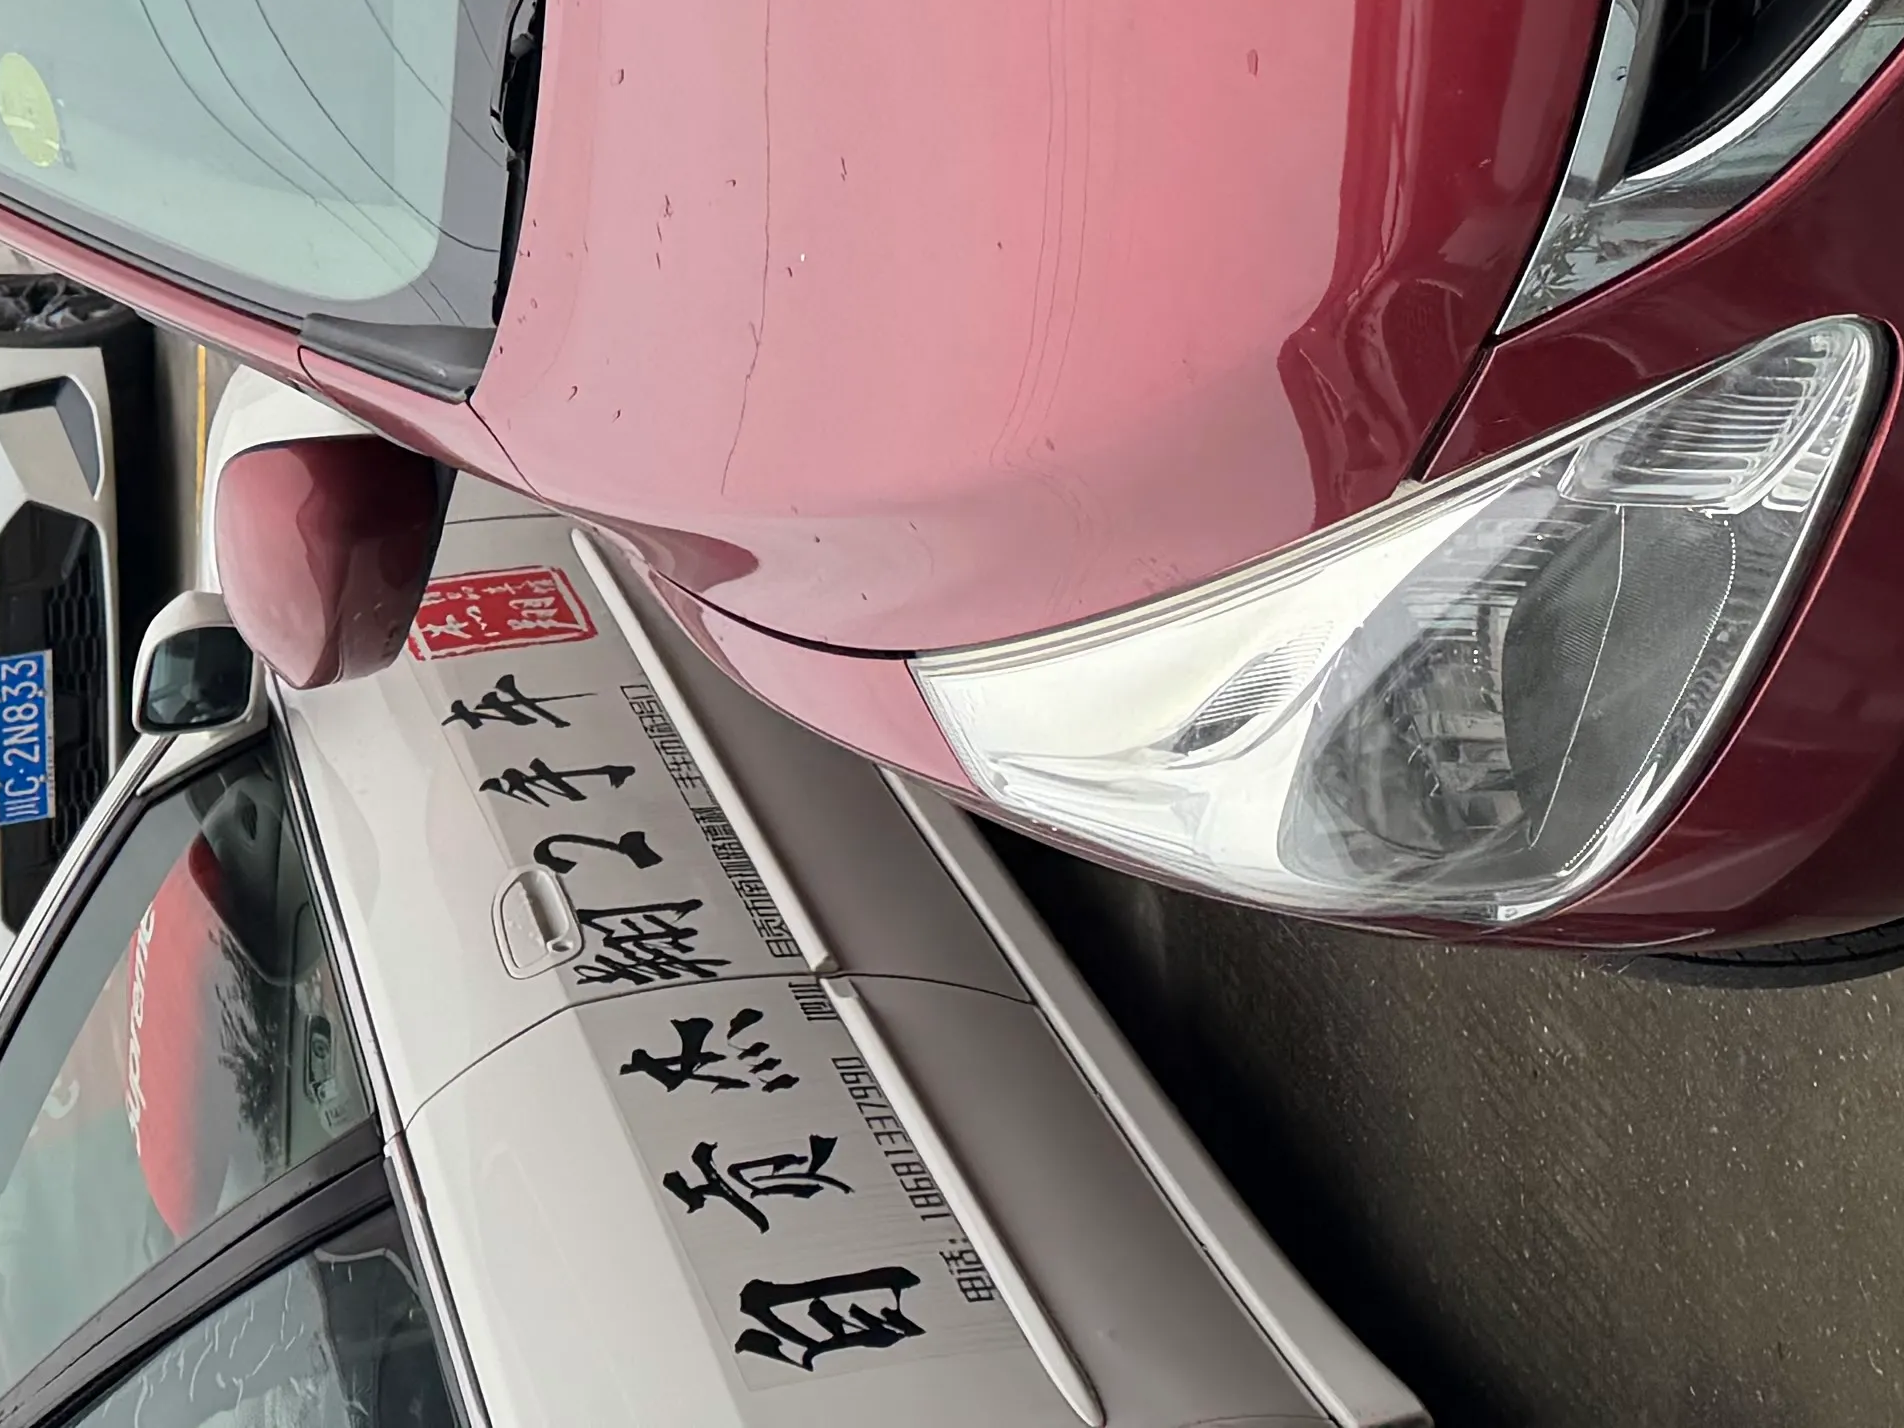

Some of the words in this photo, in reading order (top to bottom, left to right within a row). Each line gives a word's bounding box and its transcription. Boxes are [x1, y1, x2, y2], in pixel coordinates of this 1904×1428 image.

[0, 659, 41, 817] 川C·2N833
[441, 673, 925, 1372] 自贡杰翔2手车
[831, 1056, 951, 1222] 18681337990
